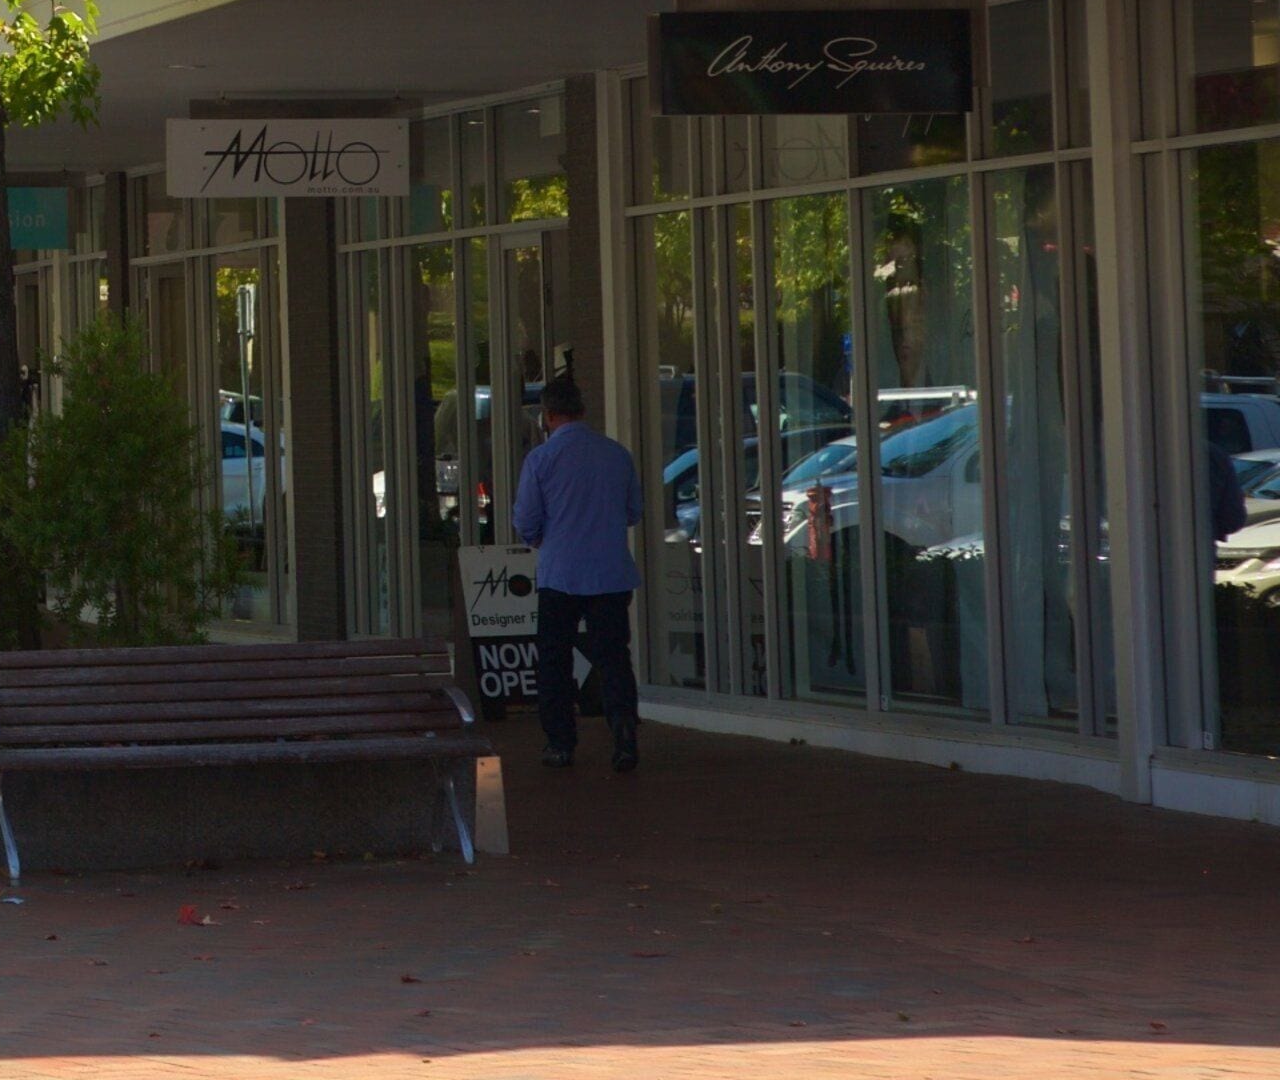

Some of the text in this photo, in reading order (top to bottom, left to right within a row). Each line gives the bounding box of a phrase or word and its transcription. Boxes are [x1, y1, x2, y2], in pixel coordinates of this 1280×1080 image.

[707, 34, 926, 90] Anthony Squires
[471, 612, 526, 628] Designer
[479, 642, 539, 670] NOW
[480, 670, 539, 698] OPE
